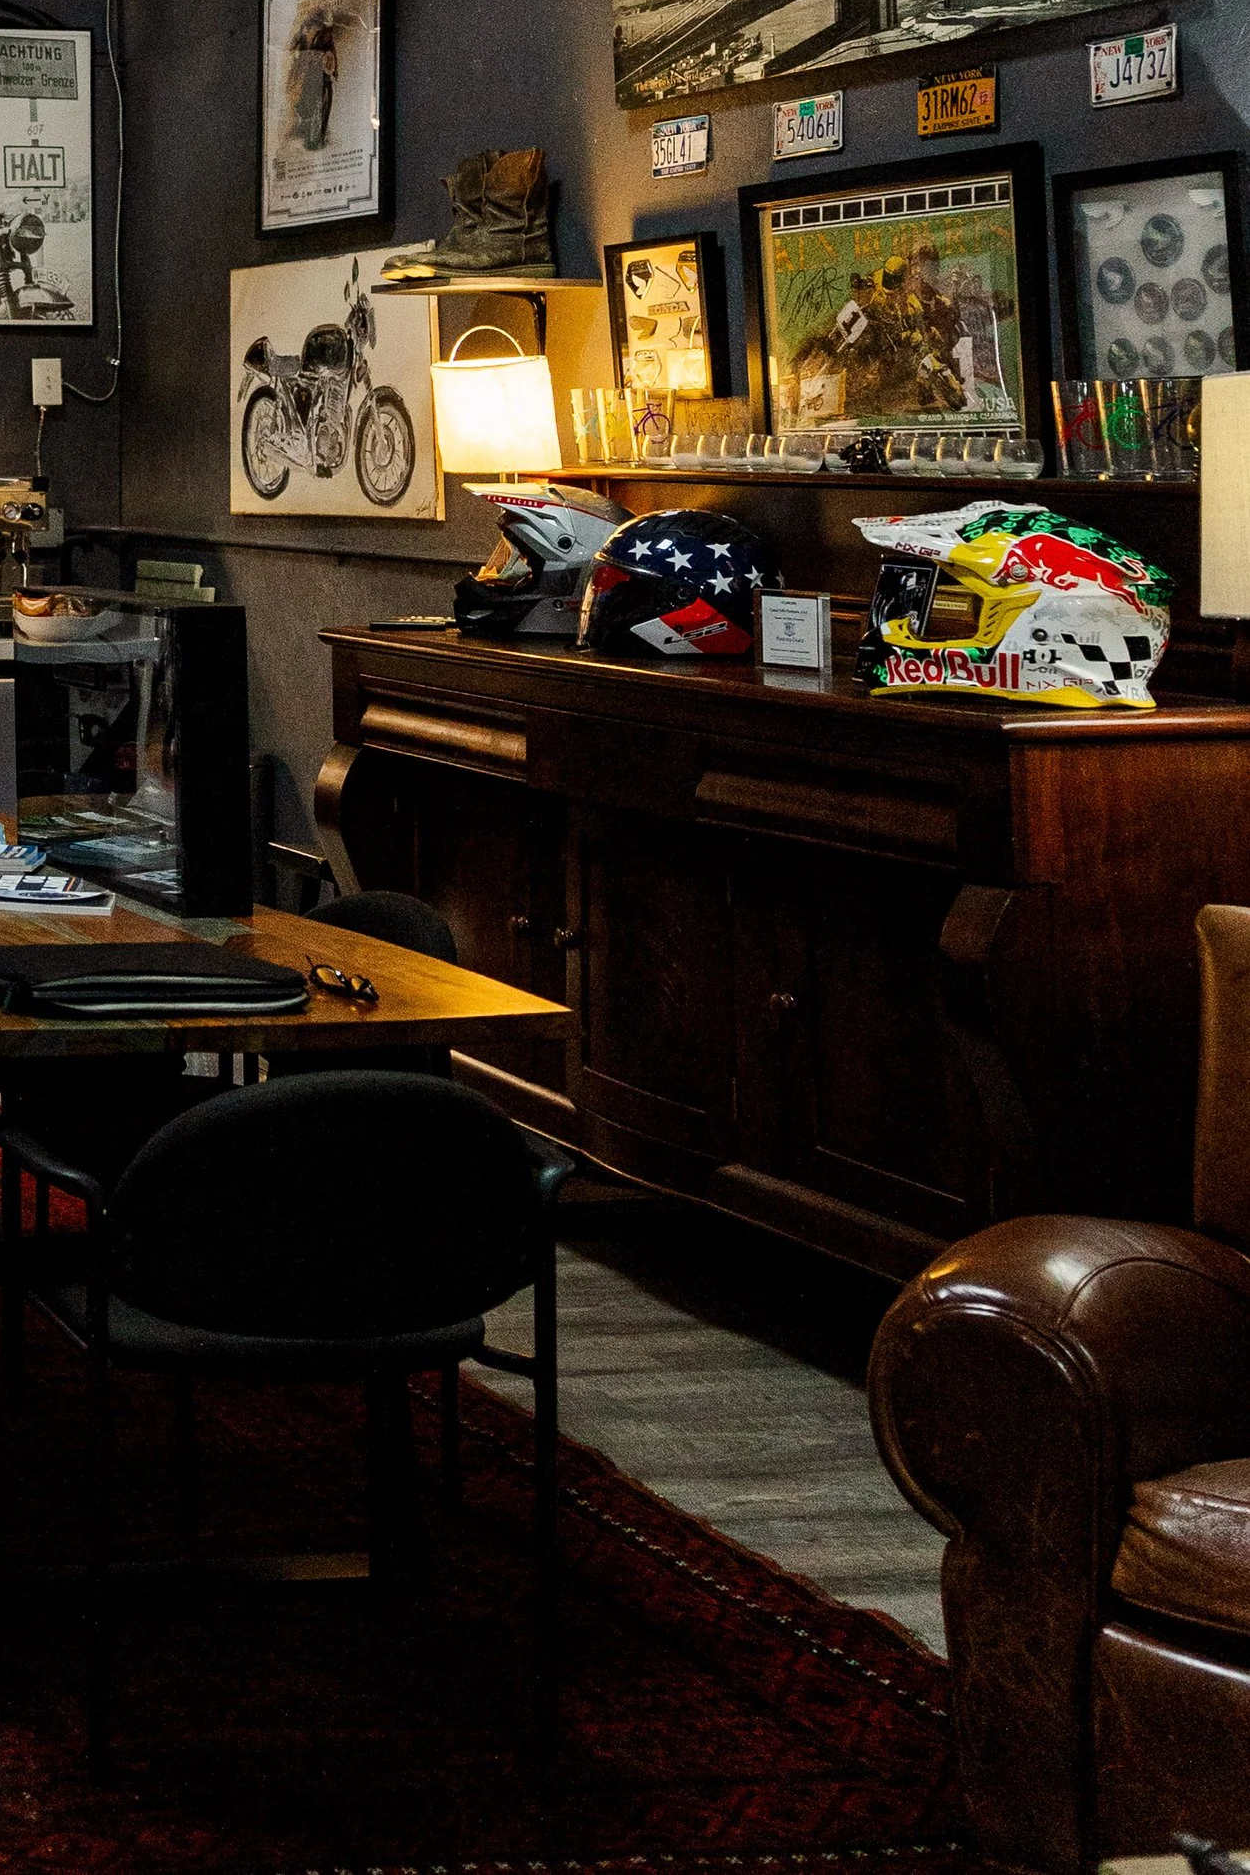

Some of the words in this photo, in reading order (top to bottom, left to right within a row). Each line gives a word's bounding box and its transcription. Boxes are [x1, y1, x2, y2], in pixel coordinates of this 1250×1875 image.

[0, 44, 62, 61] ACHTUNG
[1101, 44, 1124, 56] NEW
[1145, 35, 1167, 49] YORK
[41, 73, 75, 88] Grenze
[934, 73, 957, 85] NEW
[958, 66, 983, 80] YORK
[816, 100, 836, 112] YORK
[922, 83, 977, 122] 31RM62
[787, 111, 836, 144] 5406H
[10, 153, 61, 181] HALT
[985, 397, 1017, 412] USA
[886, 647, 944, 685] Red
[946, 650, 1020, 690] Bull
